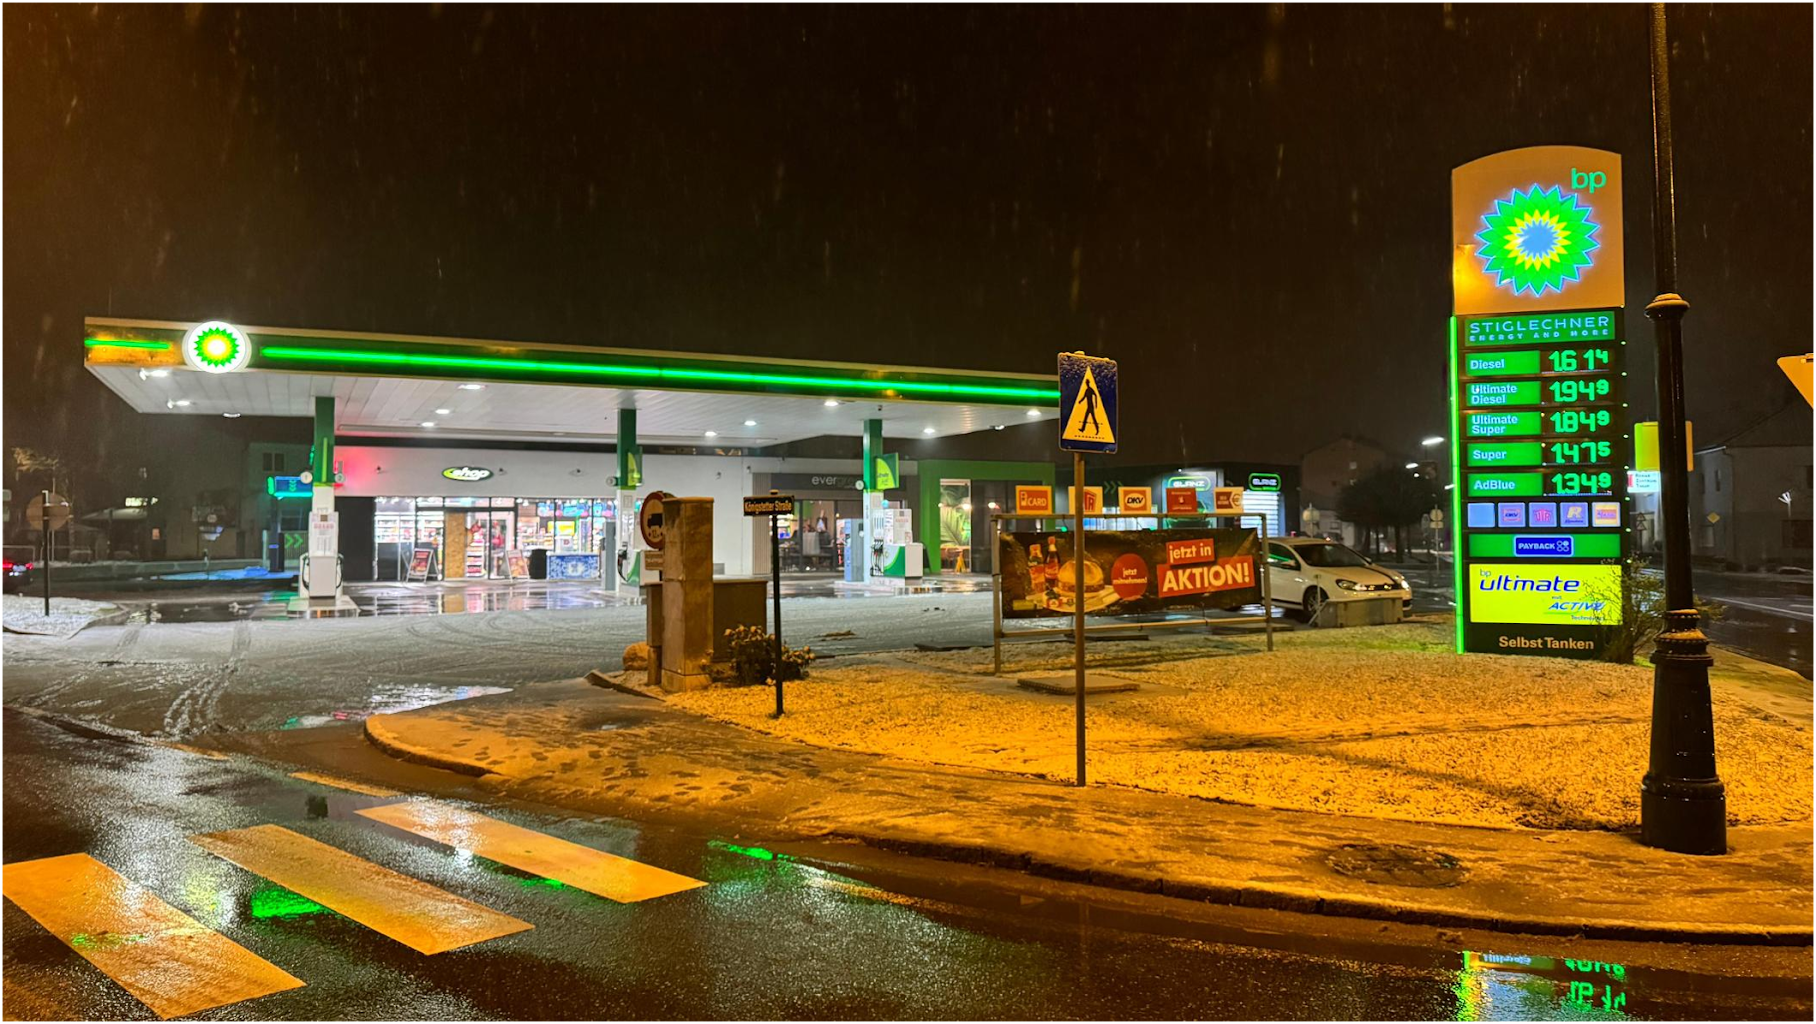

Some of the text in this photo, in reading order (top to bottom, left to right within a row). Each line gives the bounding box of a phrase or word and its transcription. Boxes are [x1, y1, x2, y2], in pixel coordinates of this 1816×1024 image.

[1571, 168, 1606, 193] bp
[1469, 316, 1609, 334] STIGLECHNER
[1469, 328, 1609, 342] ENERGY AND MORE
[1470, 358, 1505, 370] Diesel
[1471, 384, 1517, 394] Ultimate
[1471, 395, 1506, 405] Diesel
[1472, 414, 1518, 425] Ultimate
[1472, 425, 1506, 436] Super
[1473, 450, 1507, 461] Super
[452, 467, 490, 479] shop
[1252, 478, 1277, 486] GLANZ
[1474, 480, 1515, 490] AdBlue
[1028, 498, 1047, 506] CARD
[1126, 496, 1144, 504] DKV
[1169, 543, 1212, 563] jetzt in
[1122, 567, 1137, 578] jetzt
[1162, 562, 1250, 592] AKTION!
[1480, 569, 1491, 578] bp
[1480, 574, 1580, 591] ultimate
[1498, 636, 1595, 650] Selbst Tanken
